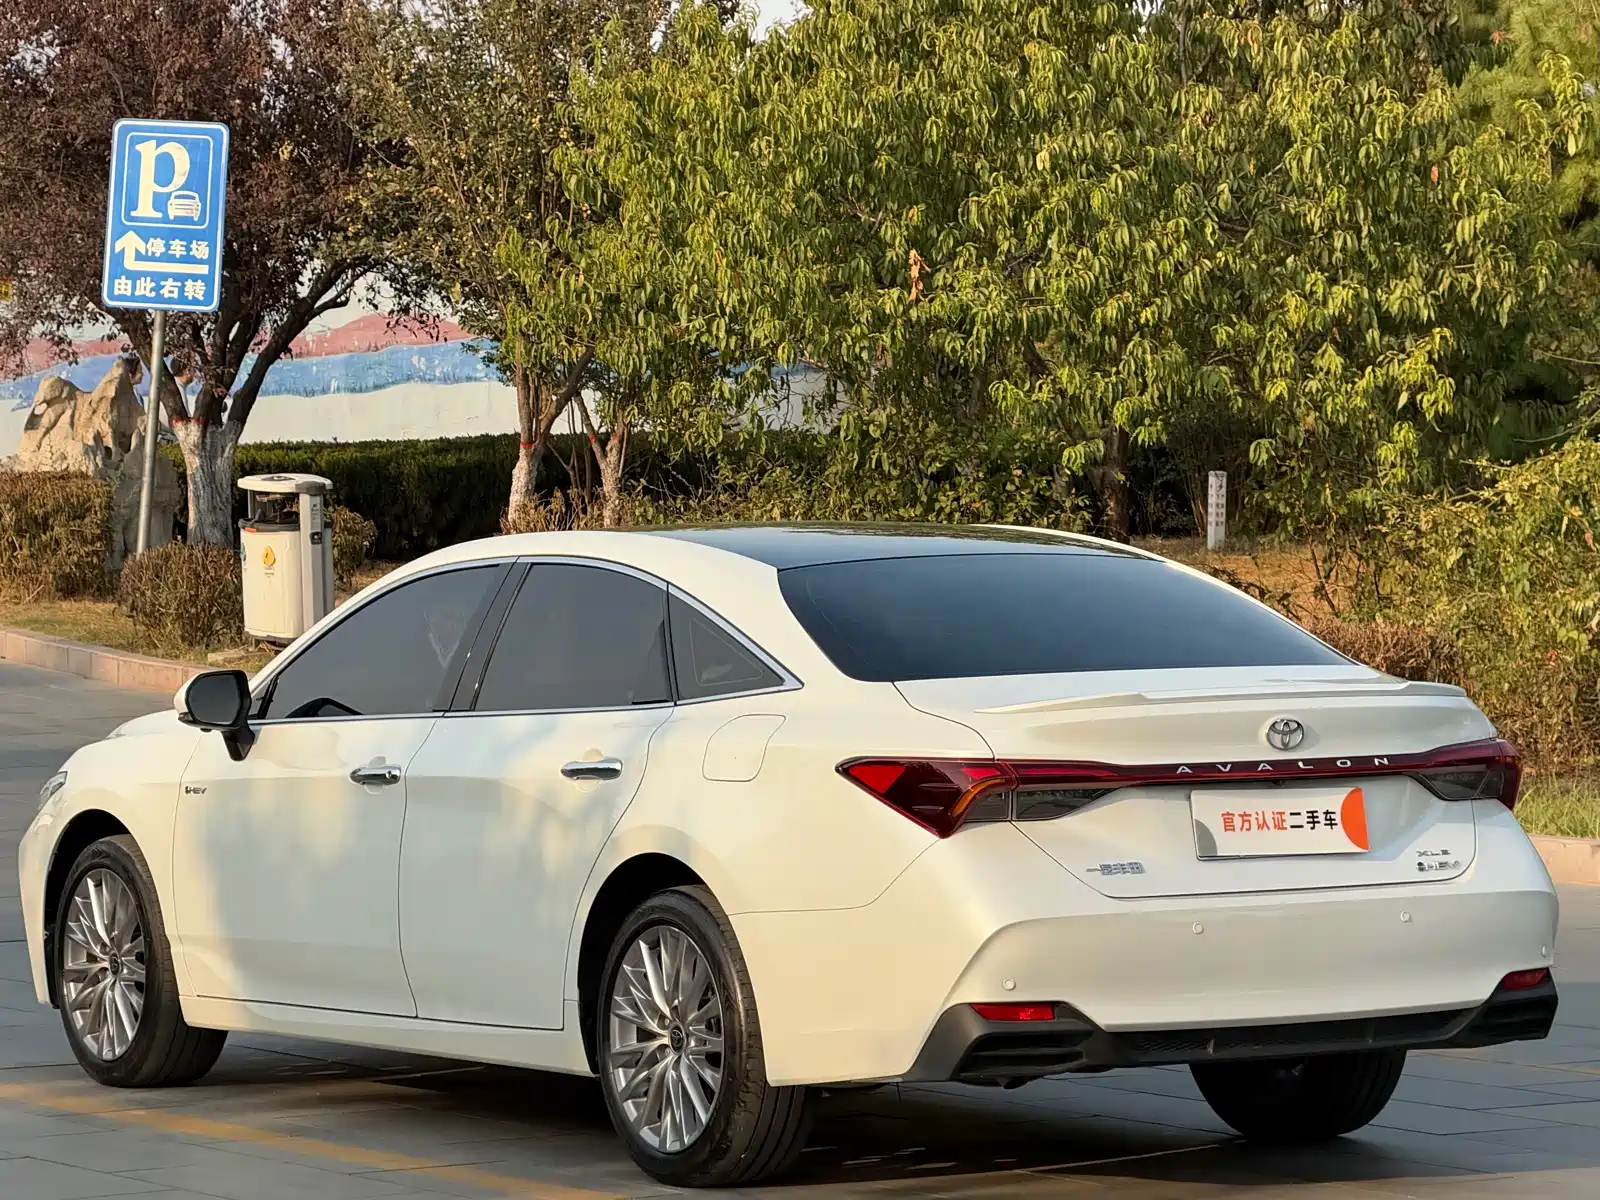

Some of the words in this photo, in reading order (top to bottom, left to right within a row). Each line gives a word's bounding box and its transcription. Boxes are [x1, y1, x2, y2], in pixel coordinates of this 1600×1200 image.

[146, 237, 210, 260] 停车场
[113, 275, 206, 301] 由此右转
[1176, 757, 1389, 774] AVALON
[1221, 809, 1339, 832] 官方认证二手车
[1416, 849, 1452, 857] XLE
